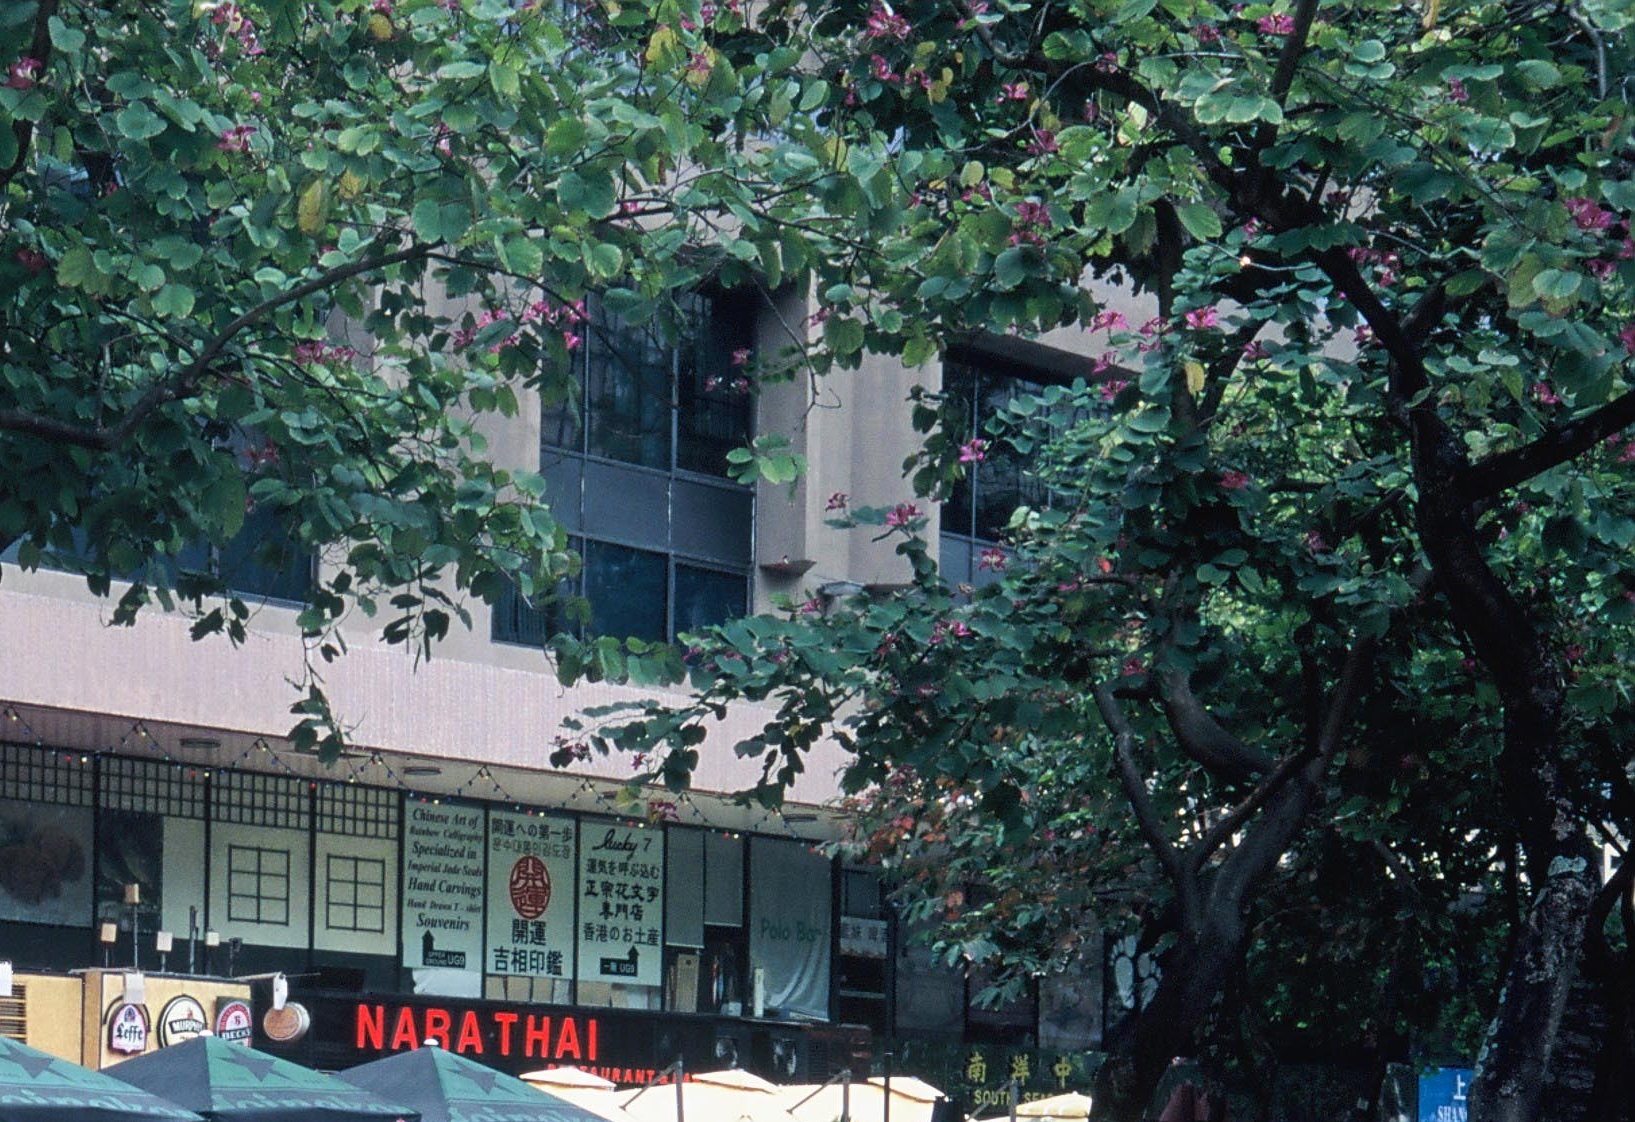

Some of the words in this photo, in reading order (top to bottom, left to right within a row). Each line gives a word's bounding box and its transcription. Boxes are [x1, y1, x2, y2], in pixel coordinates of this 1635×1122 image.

[412, 808, 450, 826] Chinese
[452, 813, 467, 828] Art
[468, 814, 479, 830] of
[412, 840, 466, 859] Specialized
[467, 846, 478, 860] in
[643, 837, 653, 853] 7
[407, 877, 436, 893] Hand
[438, 880, 482, 900] Carvings
[416, 912, 471, 931] Souvenirs
[511, 918, 547, 946] 開運
[760, 917, 790, 941] Polo
[584, 922, 660, 947] 香港のお土産
[492, 945, 563, 977] 吉相印鑑
[115, 1022, 144, 1043] Leffe
[356, 1003, 484, 1055] NARA
[494, 1012, 598, 1062] THAI
